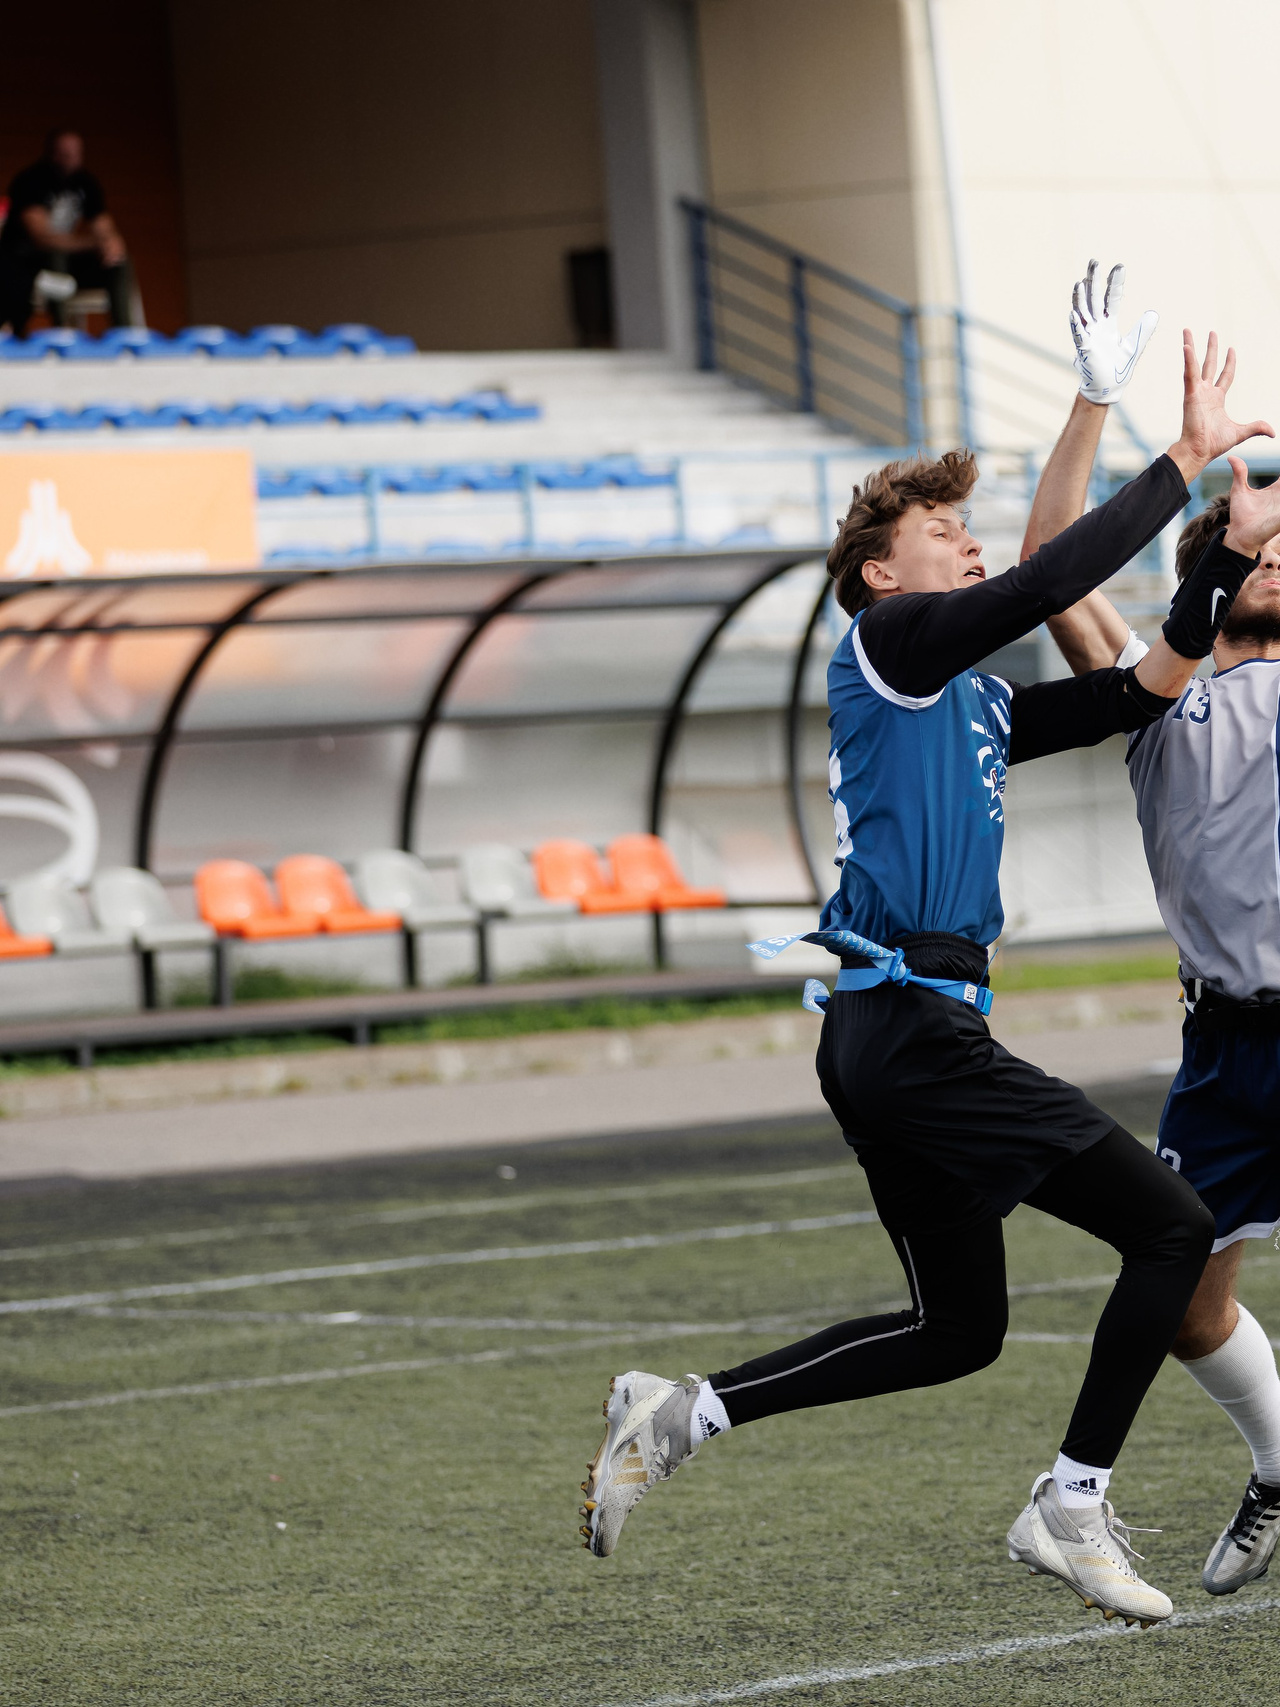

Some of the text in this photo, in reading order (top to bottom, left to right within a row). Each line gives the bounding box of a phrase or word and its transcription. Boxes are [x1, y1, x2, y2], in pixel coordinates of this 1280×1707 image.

[1173, 687, 1211, 725] 13
[697, 1412, 709, 1441] adida
[1065, 1483, 1101, 1496] adidas
